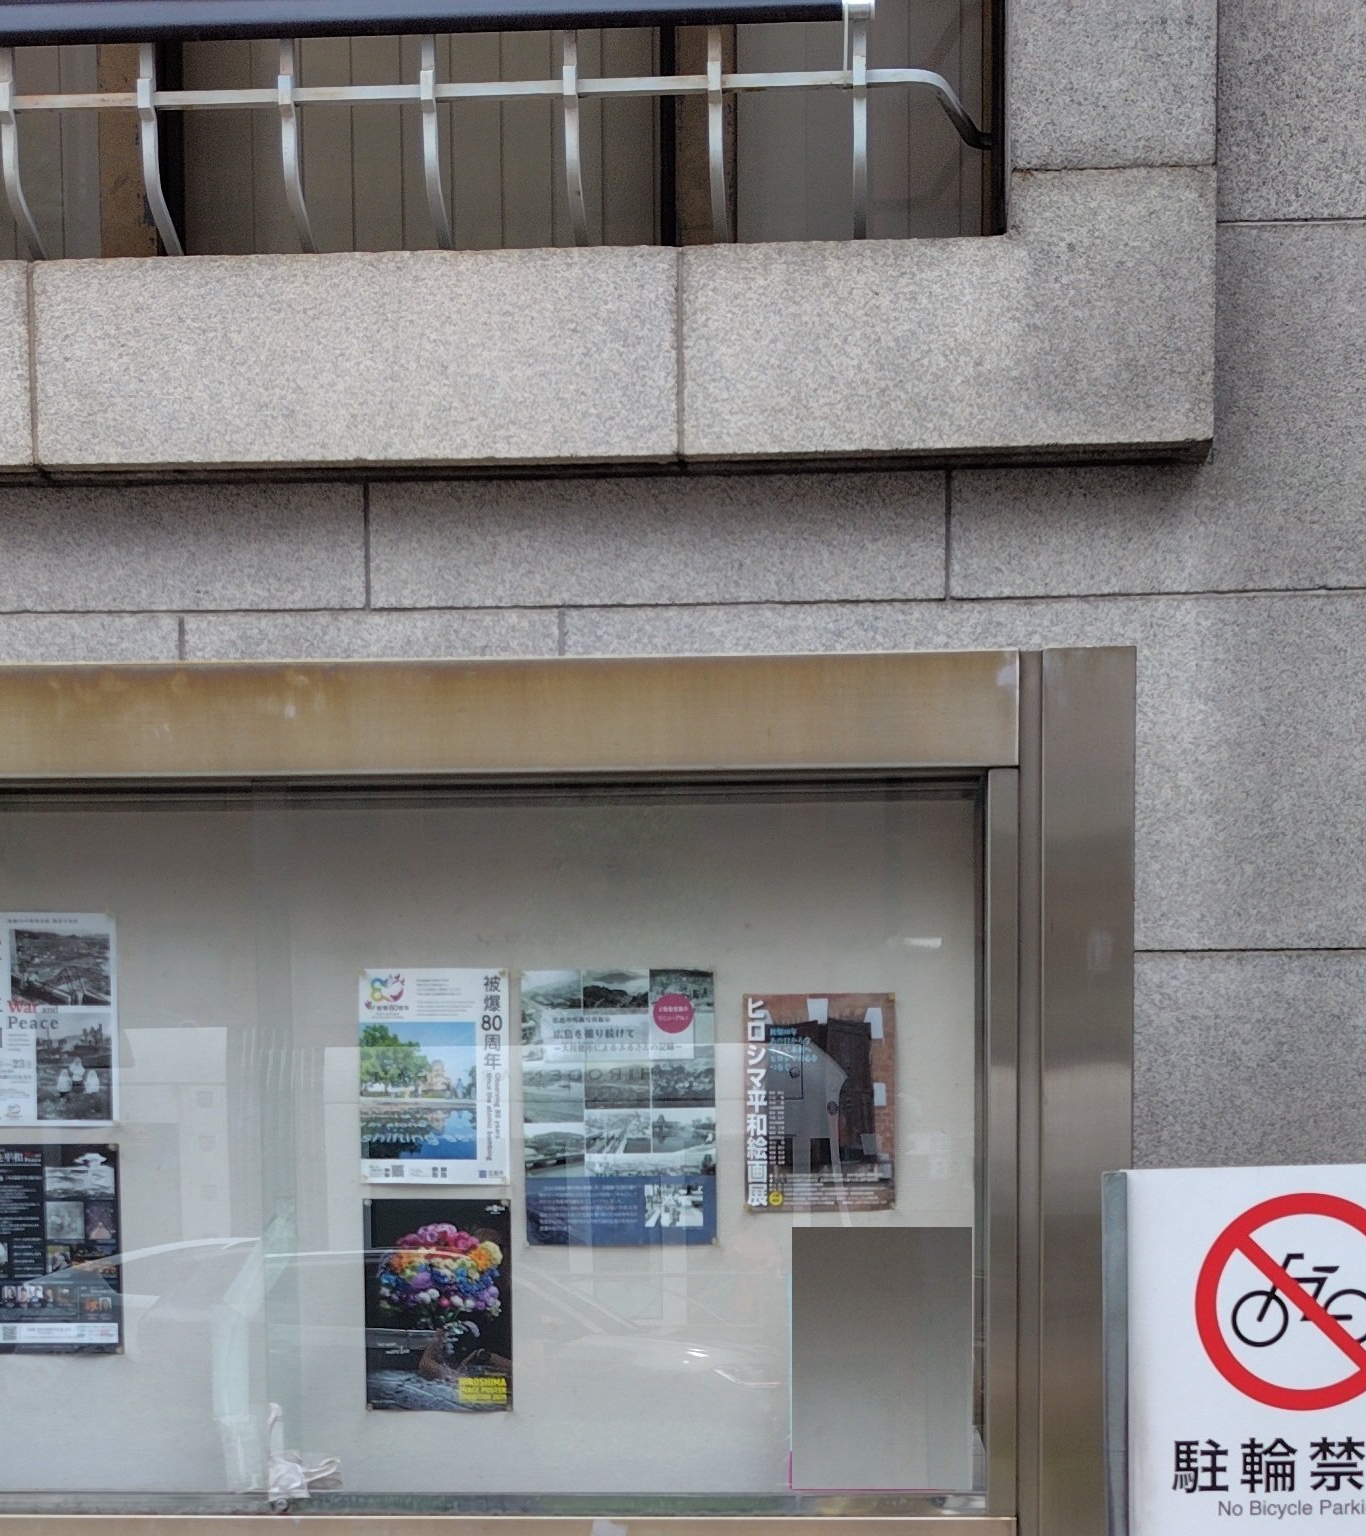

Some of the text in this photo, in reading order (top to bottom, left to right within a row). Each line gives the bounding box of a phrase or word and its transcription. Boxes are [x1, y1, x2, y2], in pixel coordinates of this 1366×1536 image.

[7, 999, 40, 1014] War
[7, 1016, 60, 1030] Peace
[481, 975, 503, 1071] 被爆80周年
[746, 997, 769, 1208] ヒロシマ平和絵画展
[1217, 1500, 1244, 1517] No
[1249, 1499, 1313, 1519] Bicycle
